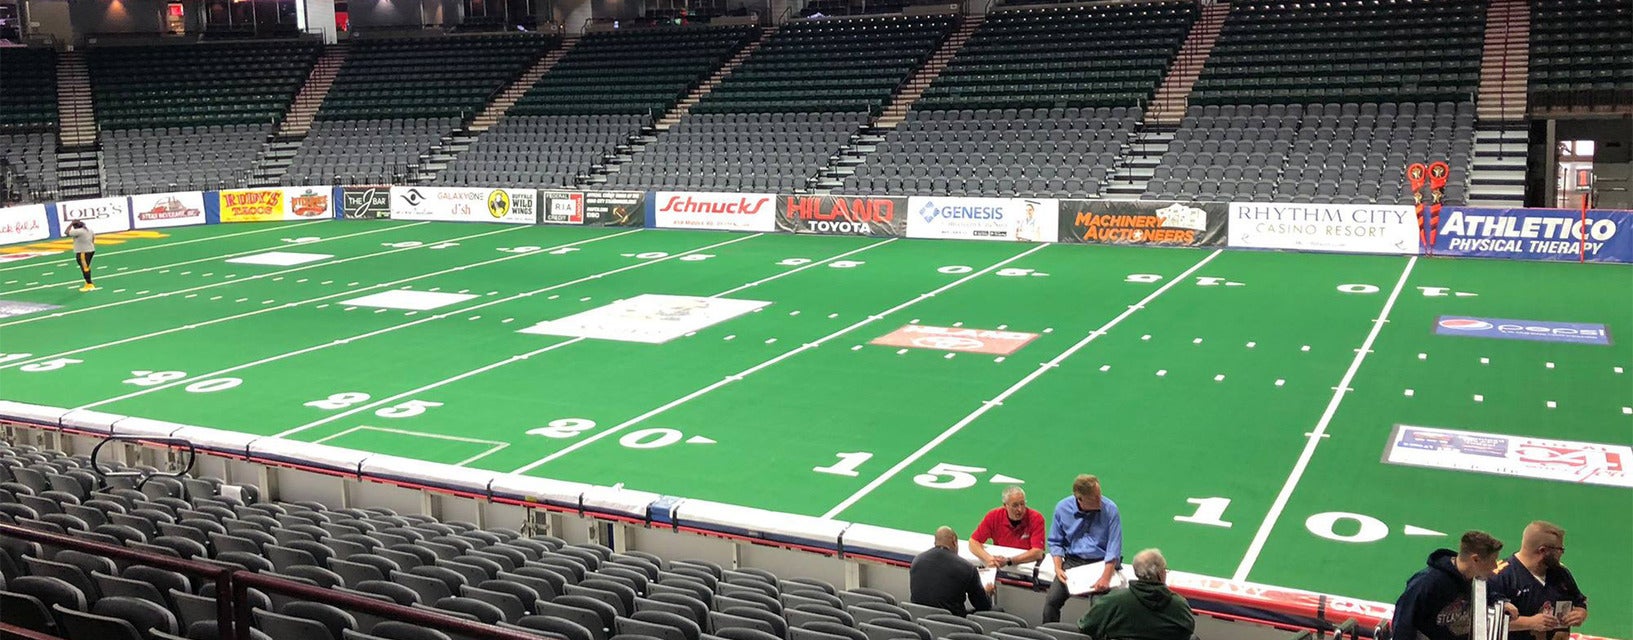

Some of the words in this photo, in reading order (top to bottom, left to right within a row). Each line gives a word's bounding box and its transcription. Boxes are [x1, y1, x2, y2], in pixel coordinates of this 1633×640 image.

[223, 191, 280, 207] RUDY'S
[349, 197, 362, 205] THE
[372, 197, 386, 205] BAR
[512, 199, 533, 208] WILD
[659, 195, 770, 215] Schnucks
[62, 203, 122, 221] Long's
[231, 206, 273, 216] TACOS
[512, 207, 533, 215] WINGS
[786, 196, 894, 223] HILAND
[941, 206, 1003, 220] GENESIS
[1238, 206, 1343, 223] RHYTHM
[1352, 208, 1408, 224] CITY
[808, 220, 871, 233] TOYOTA
[1074, 211, 1168, 228] MACHINERY
[1440, 211, 1617, 241] ATHLETICO
[1083, 225, 1195, 243] AUCTIONEERS
[1255, 222, 1317, 235] CASINO
[1325, 224, 1386, 237] RESORT
[1449, 237, 1523, 253] PHYSICAL
[1529, 240, 1604, 255] THERAPY
